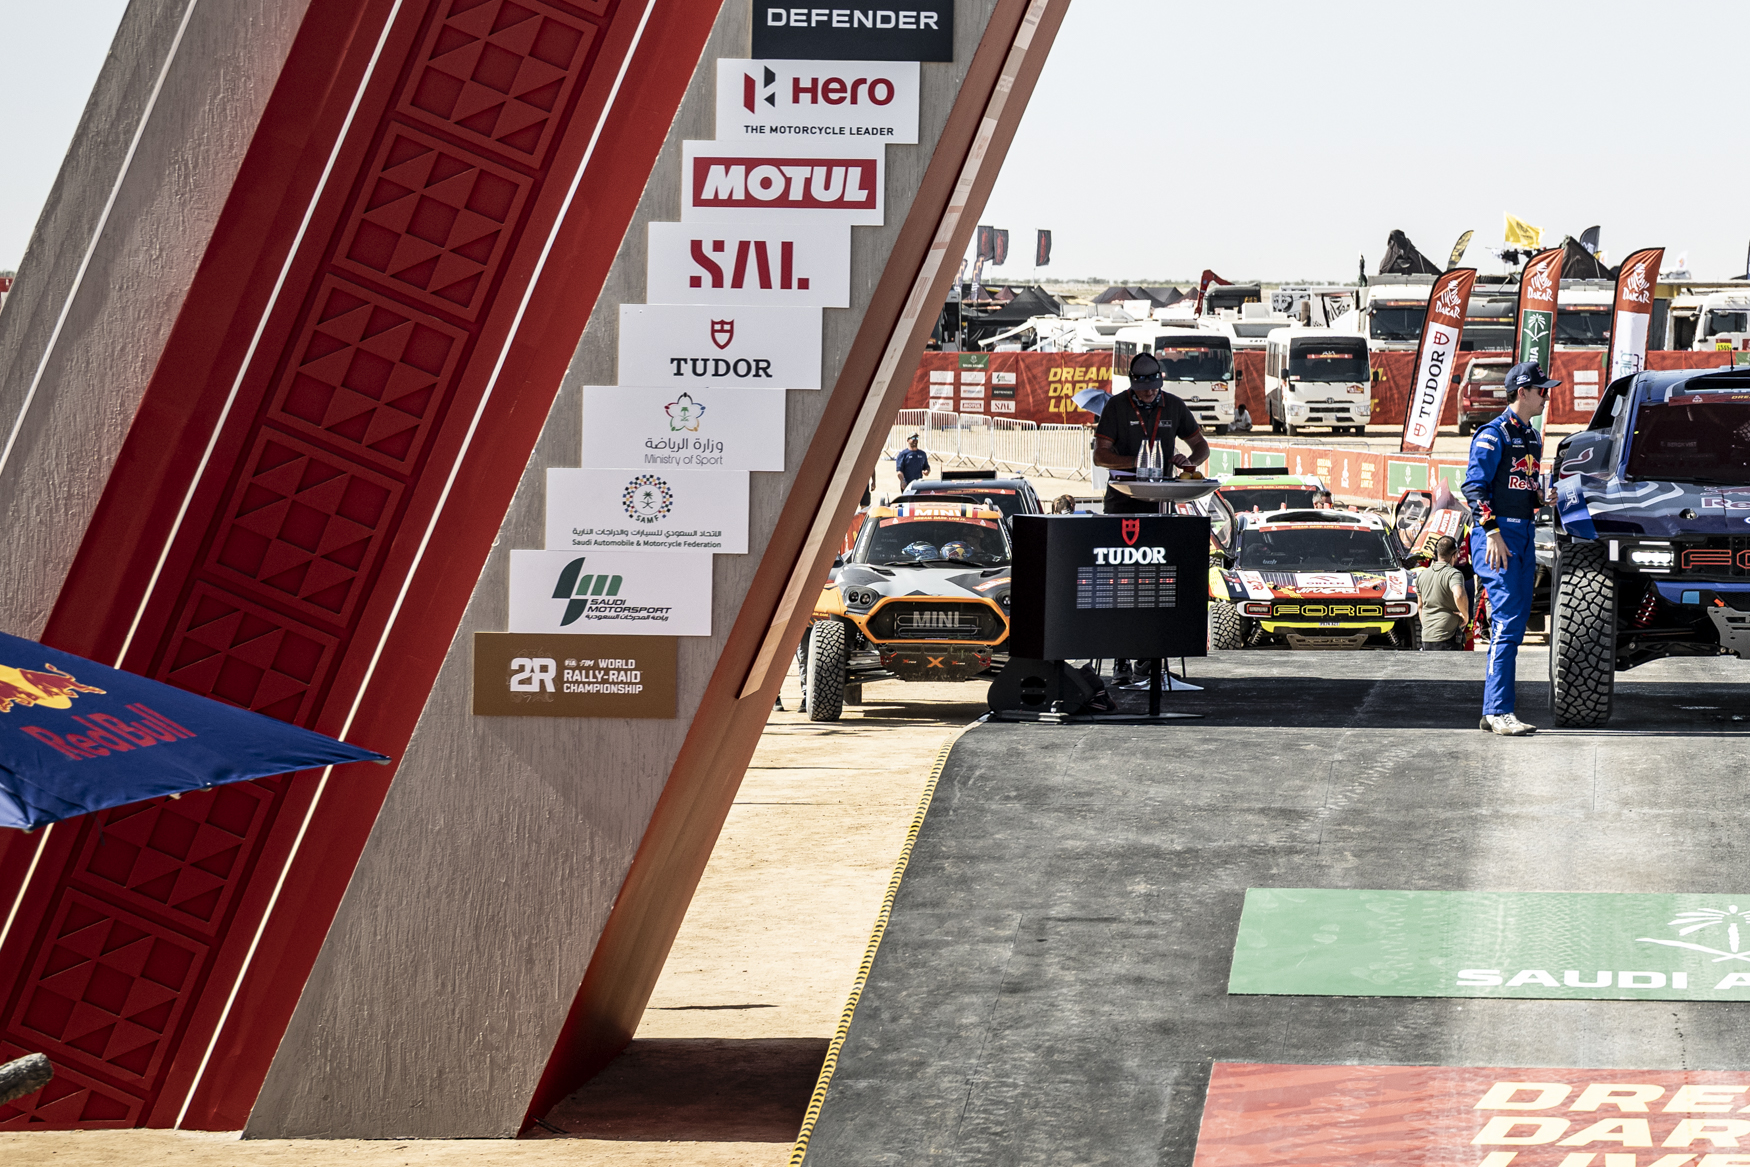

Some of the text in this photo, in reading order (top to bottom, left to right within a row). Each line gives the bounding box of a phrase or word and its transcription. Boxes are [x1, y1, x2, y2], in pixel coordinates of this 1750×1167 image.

[767, 8, 939, 30] DEFENDER
[792, 76, 895, 106] Hero
[744, 125, 894, 136] THE MOTORCYCLE LEADER
[700, 164, 870, 202] MOTUL
[1527, 286, 1554, 302] DAKAR
[1622, 288, 1650, 304] DAKAR
[1435, 302, 1462, 320] DAKAR
[1528, 346, 1540, 362] BIA
[670, 358, 772, 378] TUDOR
[1620, 351, 1632, 377] ain
[1420, 350, 1446, 419] TUDOR
[645, 437, 724, 454] وزارة الرياضة
[645, 454, 724, 468] Ministry of Sport
[635, 514, 660, 524] SAMF
[914, 508, 962, 516] MINI
[572, 528, 594, 536] النارية
[595, 528, 629, 536] والدراجات
[630, 529, 662, 537] للسيارات
[664, 530, 698, 538] السعودي
[643, 540, 682, 548] Motorcycle
[1424, 536, 1438, 552] 221
[1093, 547, 1166, 564] TUDOR
[587, 606, 672, 614] MOTORSPORT
[1274, 604, 1382, 616] FORD
[912, 611, 960, 628] MINI
[598, 659, 636, 668] WORLD
[510, 658, 556, 692] 2R
[564, 670, 640, 682] RALLY-RAID
[563, 684, 643, 694] CHAMPIONSHIP
[20, 702, 197, 760] Red Bull
[1456, 968, 1689, 990] SAUDI
